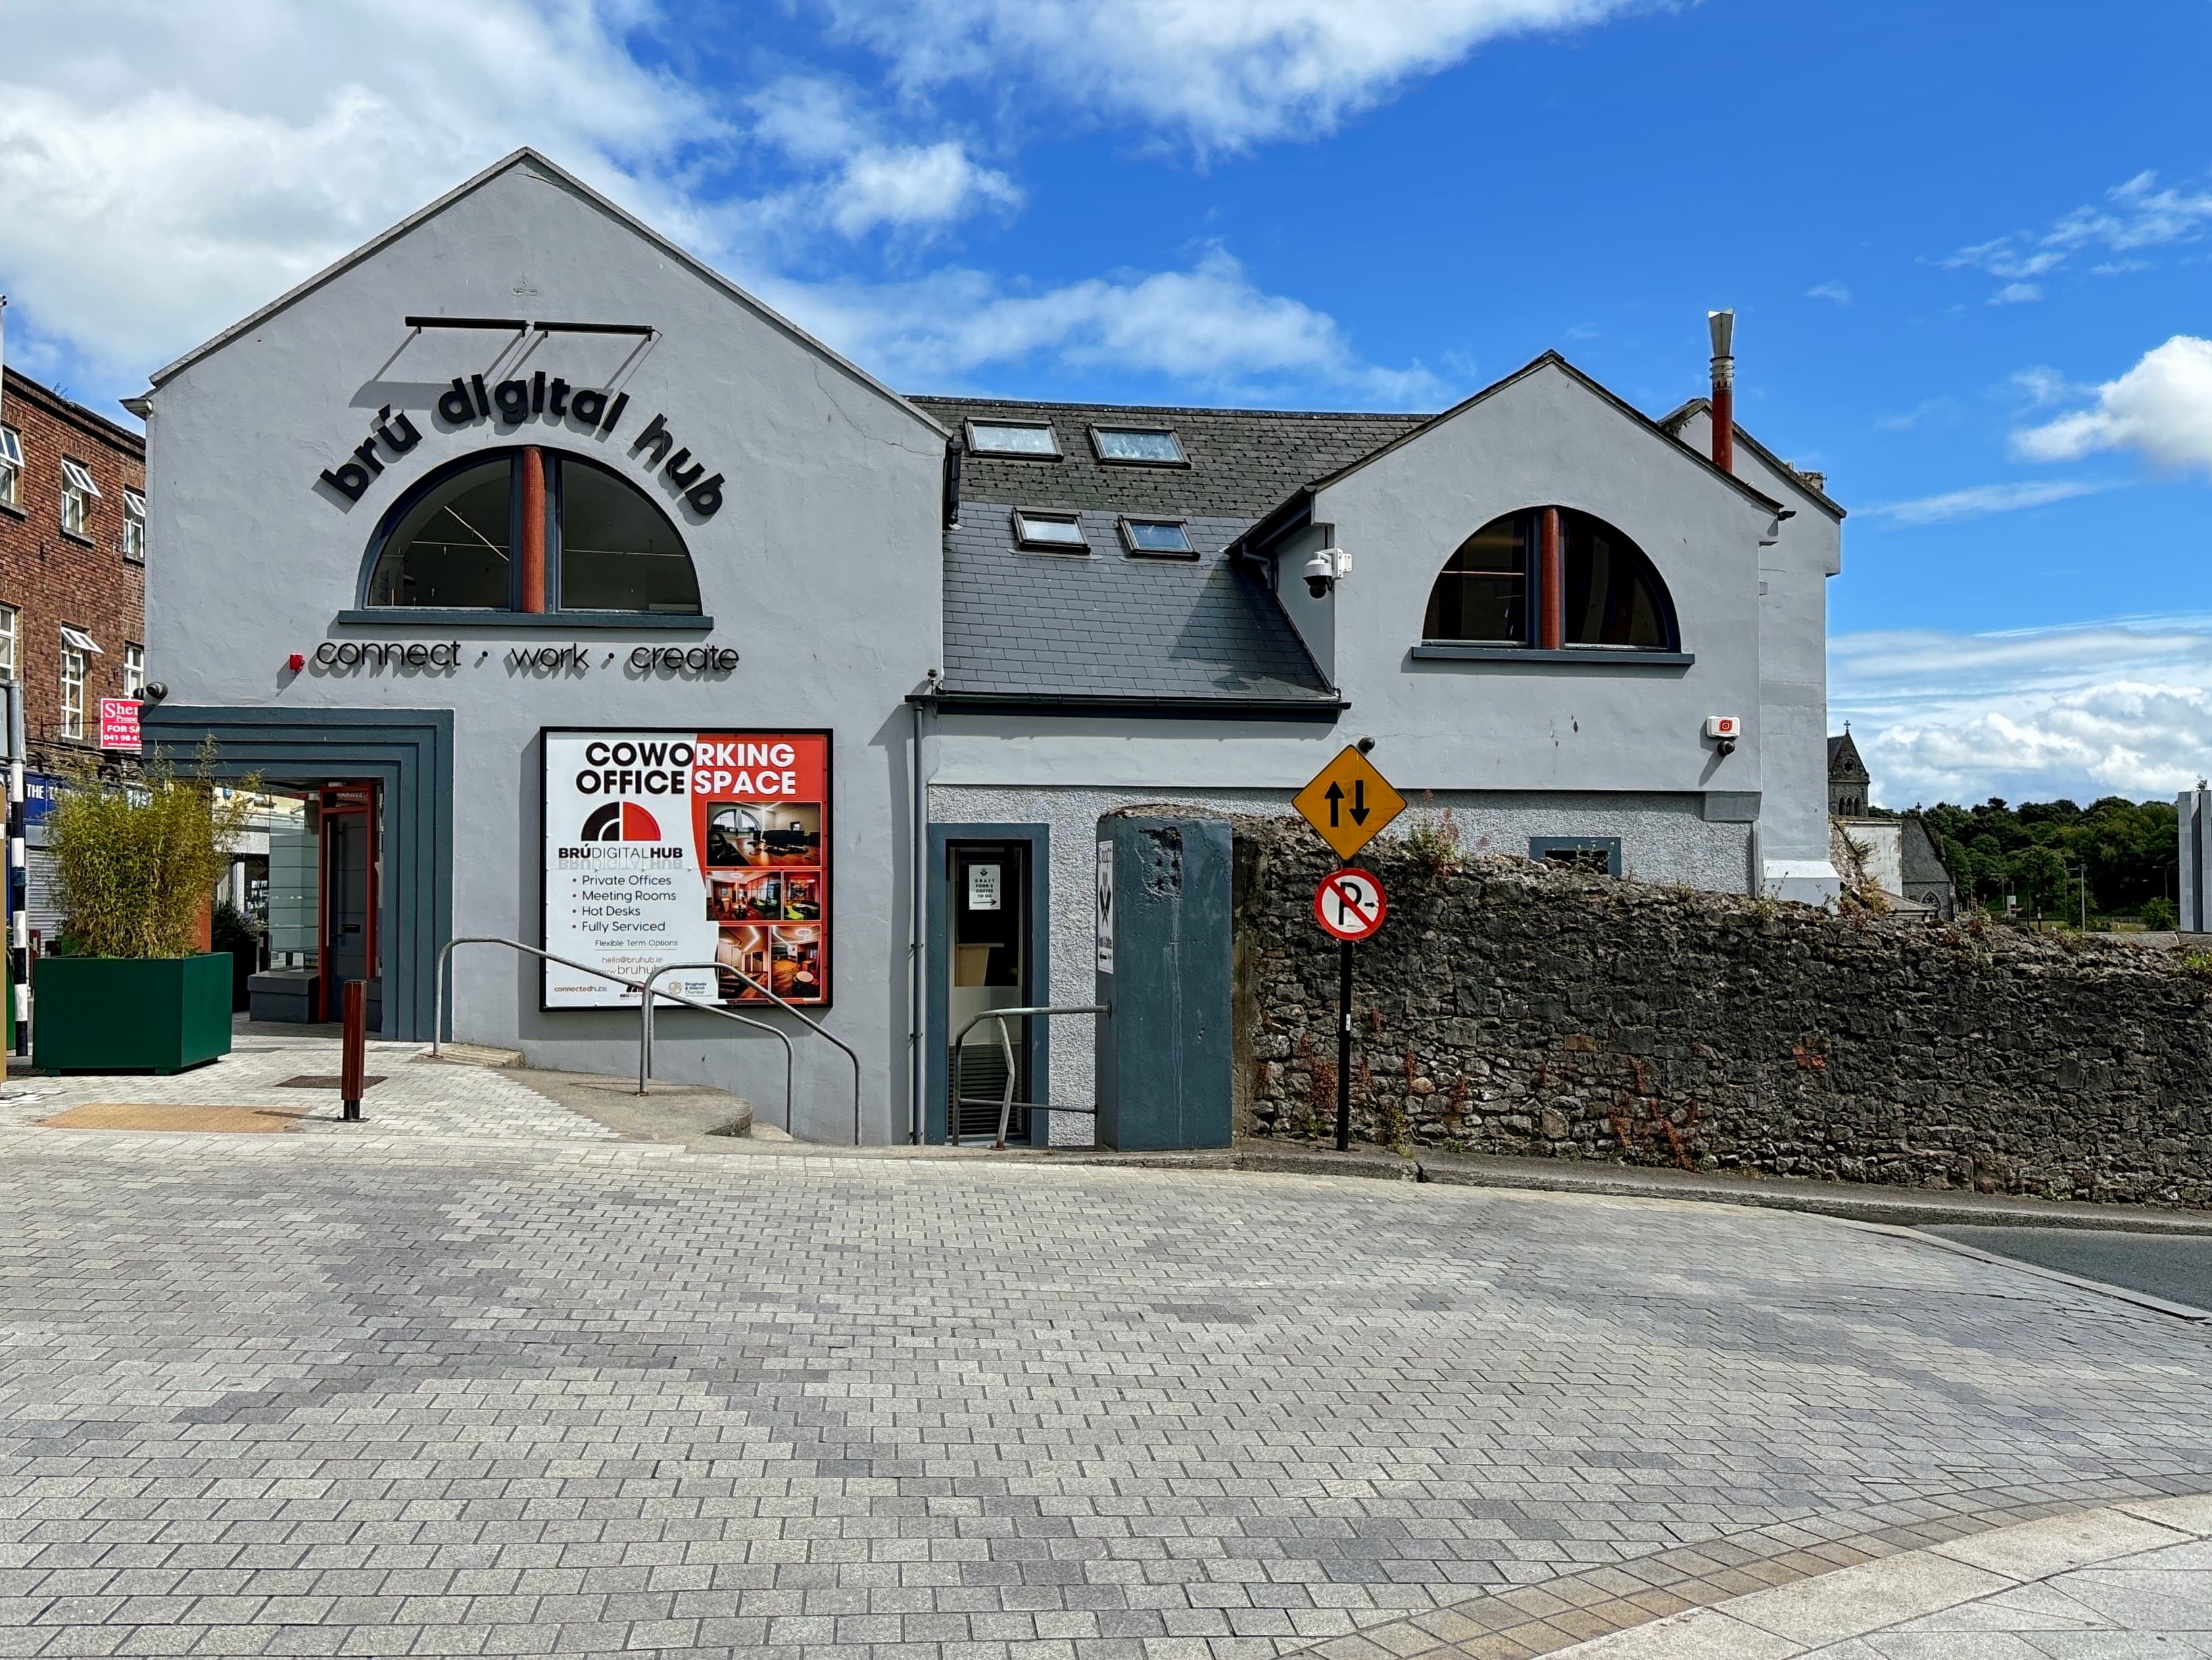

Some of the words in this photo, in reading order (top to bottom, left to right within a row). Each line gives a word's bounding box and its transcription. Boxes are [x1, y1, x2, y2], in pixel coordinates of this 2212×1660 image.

[320, 404, 422, 502] brú
[438, 371, 629, 433] digital
[634, 413, 725, 515] hub
[316, 640, 461, 666] connect
[512, 642, 590, 667] work
[631, 644, 740, 670] create
[585, 742, 795, 768] COWORKING
[576, 769, 685, 795] OFFICE
[694, 771, 796, 795] SPACE
[26, 784, 45, 799] THE
[582, 875, 625, 886] Private
[629, 875, 671, 886] Offices
[582, 891, 632, 903] Meeting
[635, 891, 676, 901] Rooms
[582, 906, 603, 916] Hot
[606, 906, 641, 916] Desks
[582, 921, 609, 933] Fully
[612, 921, 666, 932] Serviced
[648, 939, 678, 947] Options
